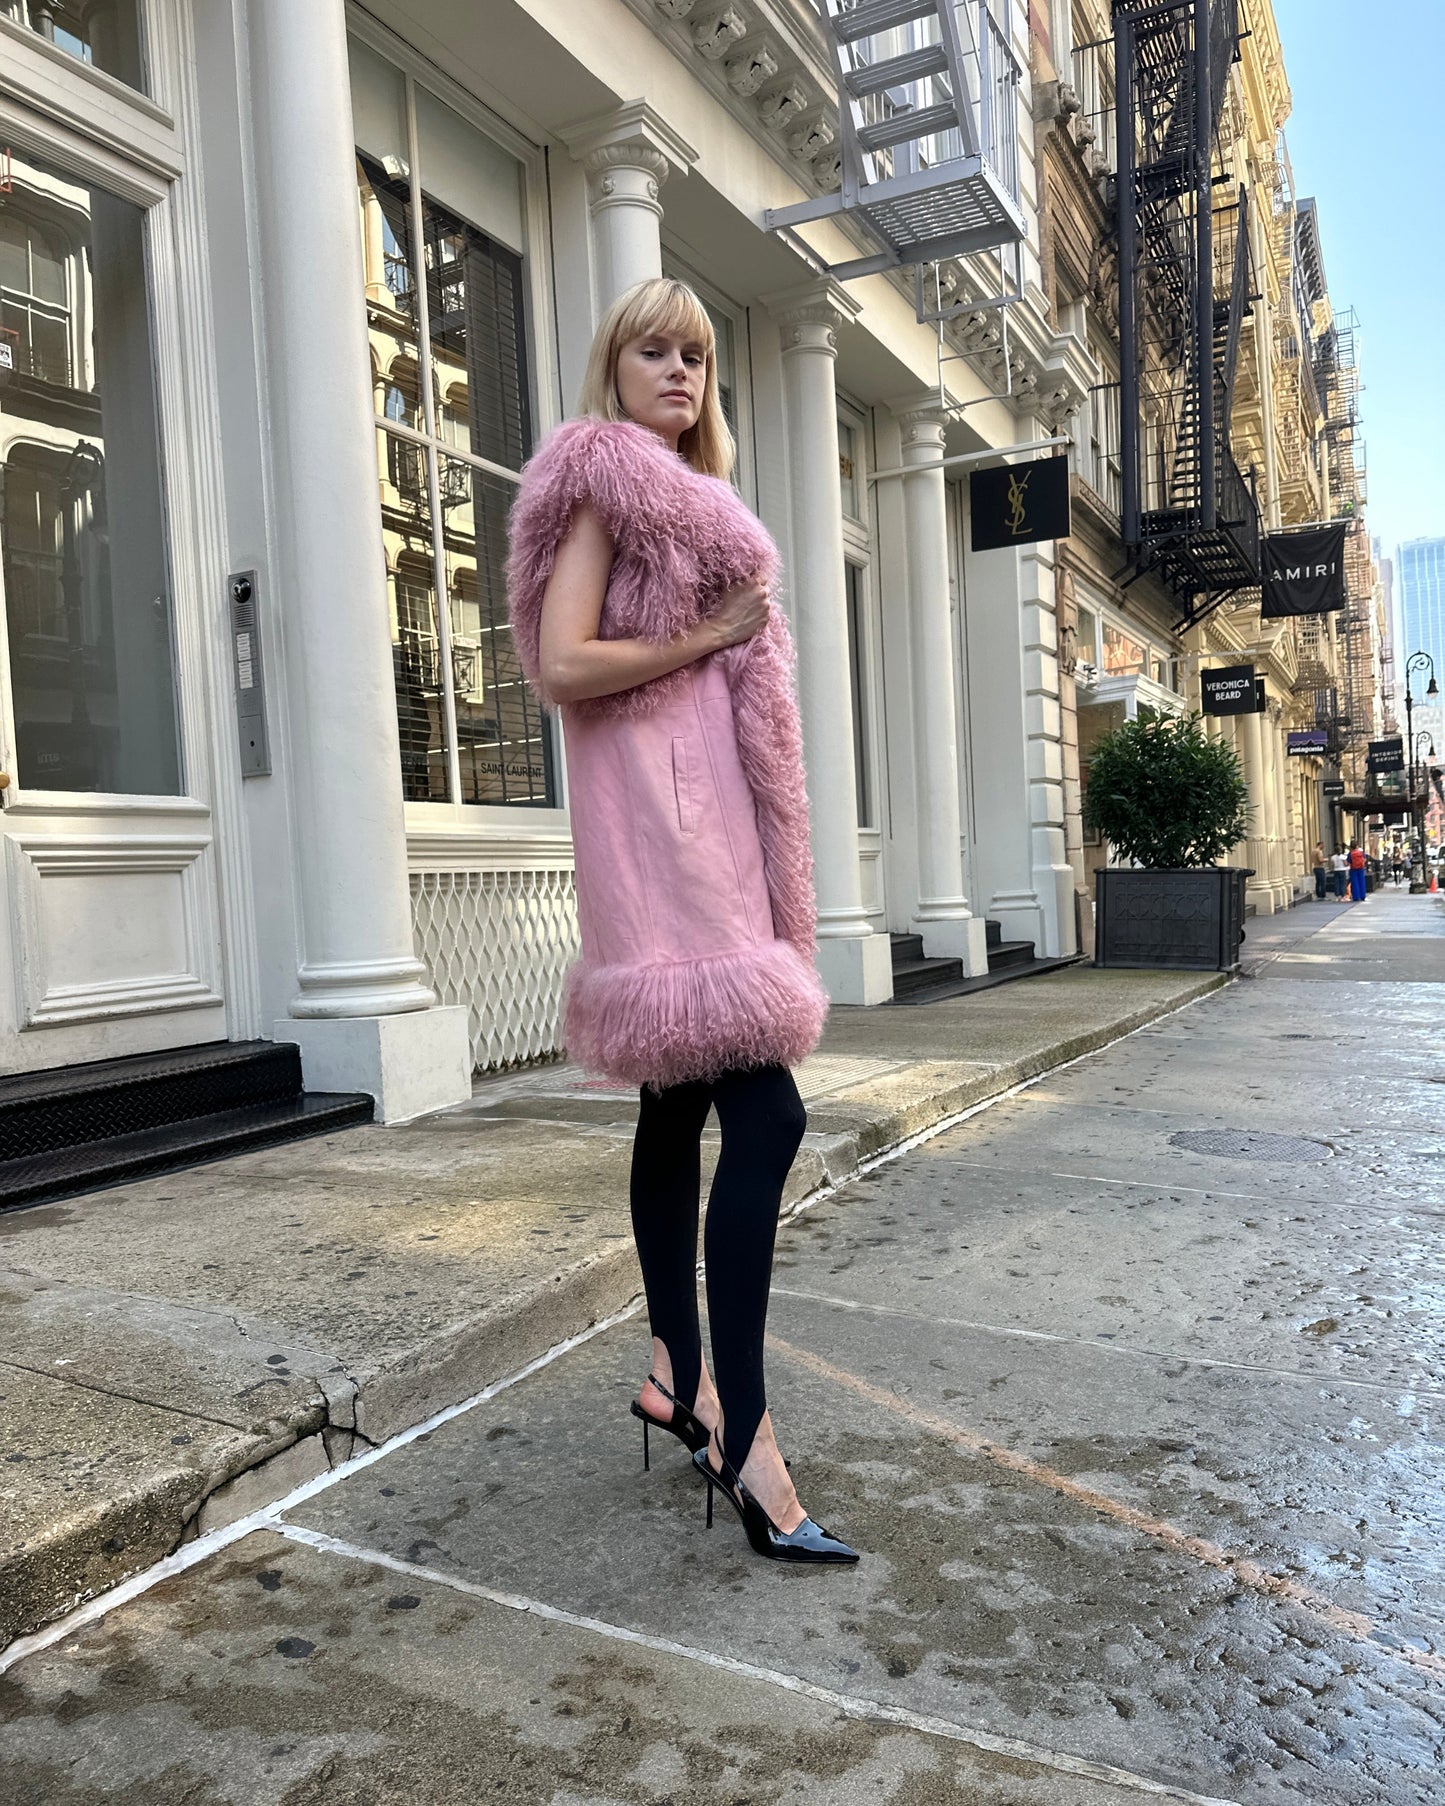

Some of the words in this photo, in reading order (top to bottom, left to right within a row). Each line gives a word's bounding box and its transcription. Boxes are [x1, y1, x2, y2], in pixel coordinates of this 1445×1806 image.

[1270, 562, 1335, 581] AMIRI
[1206, 679, 1250, 692] VERONICA
[1215, 690, 1241, 701] BEARD
[1289, 745, 1324, 754] patagonia
[480, 762, 504, 775] SAINT
[506, 764, 542, 778] LAURENT
